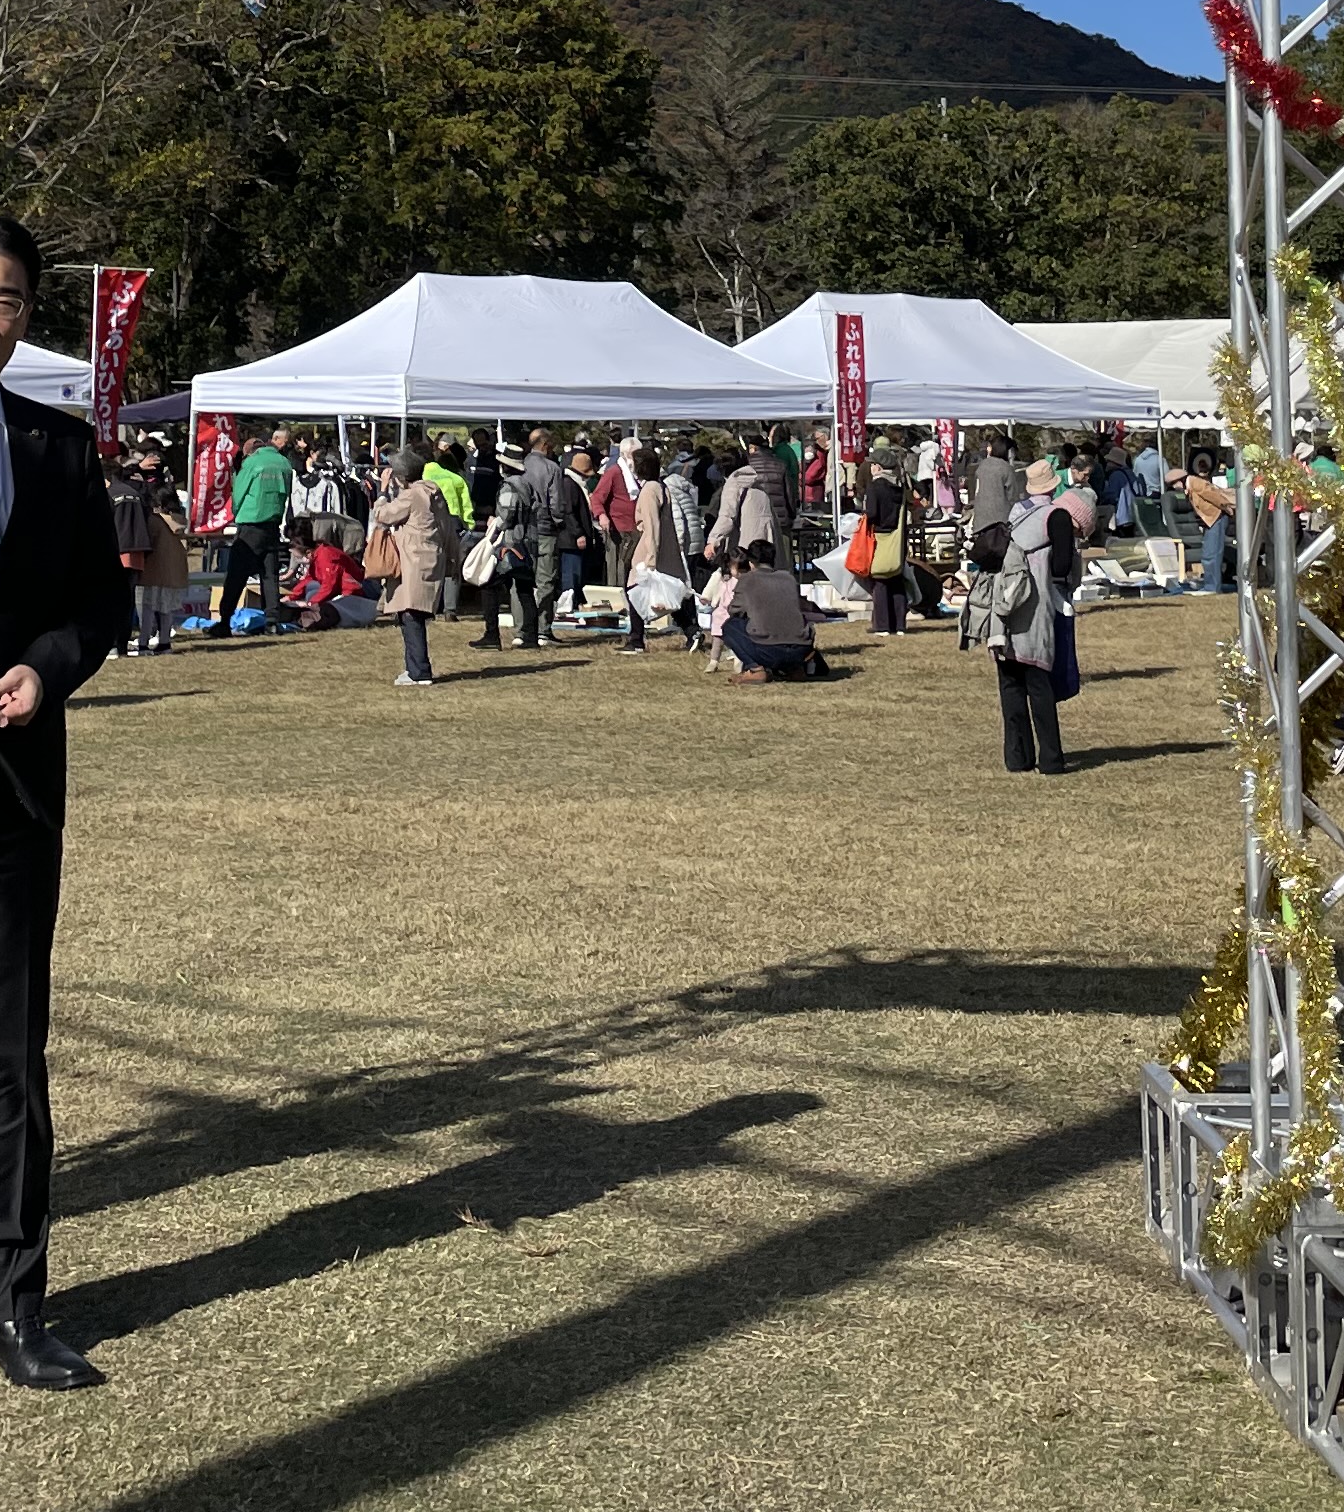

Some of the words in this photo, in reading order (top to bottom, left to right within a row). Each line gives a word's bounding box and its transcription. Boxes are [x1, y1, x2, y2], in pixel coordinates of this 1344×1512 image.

[845, 322, 862, 454] ふれあいひろば
